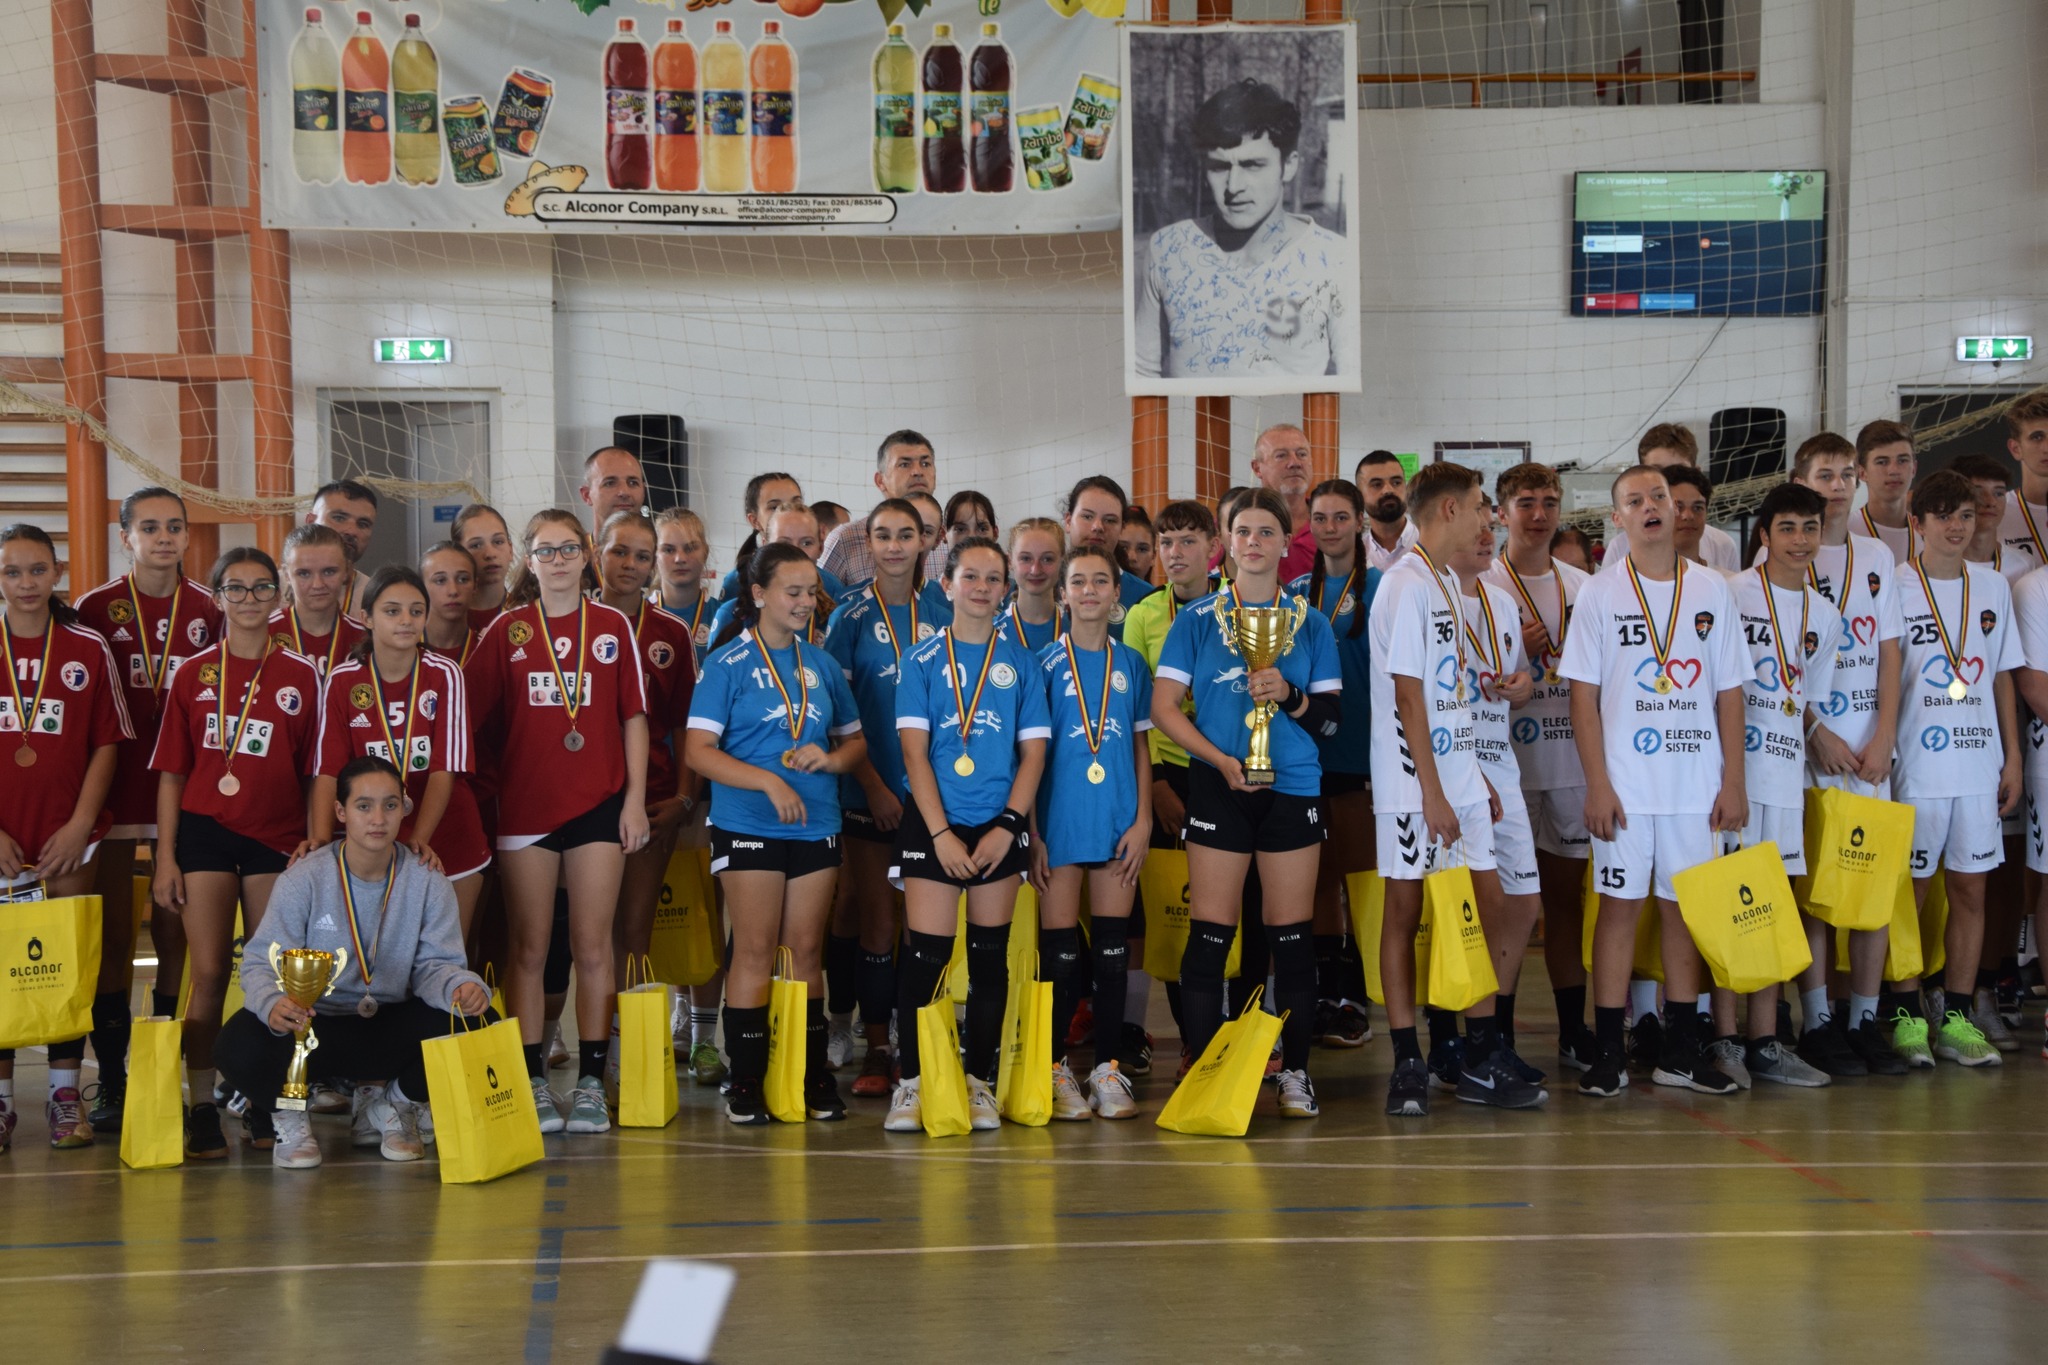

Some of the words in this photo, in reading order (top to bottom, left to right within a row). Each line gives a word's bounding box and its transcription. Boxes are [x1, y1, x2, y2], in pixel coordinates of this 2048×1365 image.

[501, 104, 539, 119] zamba
[1074, 100, 1115, 120] zamba
[452, 127, 489, 150] zamba
[1023, 130, 1063, 150] zamba
[566, 200, 624, 213] Alconor
[629, 201, 699, 217] Company
[702, 207, 728, 215] S.R.L.
[738, 207, 841, 215] office@alconor-company.ro
[738, 213, 836, 221] www.alconor-company.ro
[2005, 536, 2033, 546] humme
[1292, 579, 1312, 589] Kemp
[1614, 614, 1646, 622] humme
[1905, 615, 1934, 624] humme
[874, 621, 891, 643] 6
[1434, 620, 1454, 644] 36
[1618, 625, 1647, 646] 15
[1744, 624, 1772, 646] 14
[1911, 623, 1940, 645] 25
[555, 637, 572, 659] 9
[726, 648, 750, 665] Kempa
[918, 643, 942, 663] Kempa
[16, 658, 41, 681] 11
[1045, 652, 1068, 672] Kempa
[752, 667, 776, 689] 17
[941, 663, 967, 688] 10
[1064, 671, 1079, 696] 2
[240, 682, 261, 704] 2
[1549, 686, 1572, 699] Mar
[1924, 695, 1953, 707] Baia
[1636, 700, 1665, 712] Baia
[1668, 699, 1698, 711] Mare
[1748, 694, 1776, 710] Baia
[388, 701, 405, 727] 5
[1481, 710, 1506, 723] Mare
[1665, 730, 1711, 740] ELECTRO
[1954, 727, 1993, 738] ELECTRO
[1665, 743, 1701, 753] SISTEM
[1765, 745, 1796, 762] SISTEM
[845, 810, 874, 824] Kempa
[1190, 818, 1217, 831] Kempa
[1307, 808, 1319, 825] 16
[732, 840, 764, 849] Kempa
[1780, 851, 1800, 861] ummel
[1600, 866, 1626, 889] 15
[1733, 902, 1772, 924] alconor
[1103, 947, 1124, 955] SELECT
[10, 963, 62, 977] alconor
[485, 1089, 513, 1107] alconor
